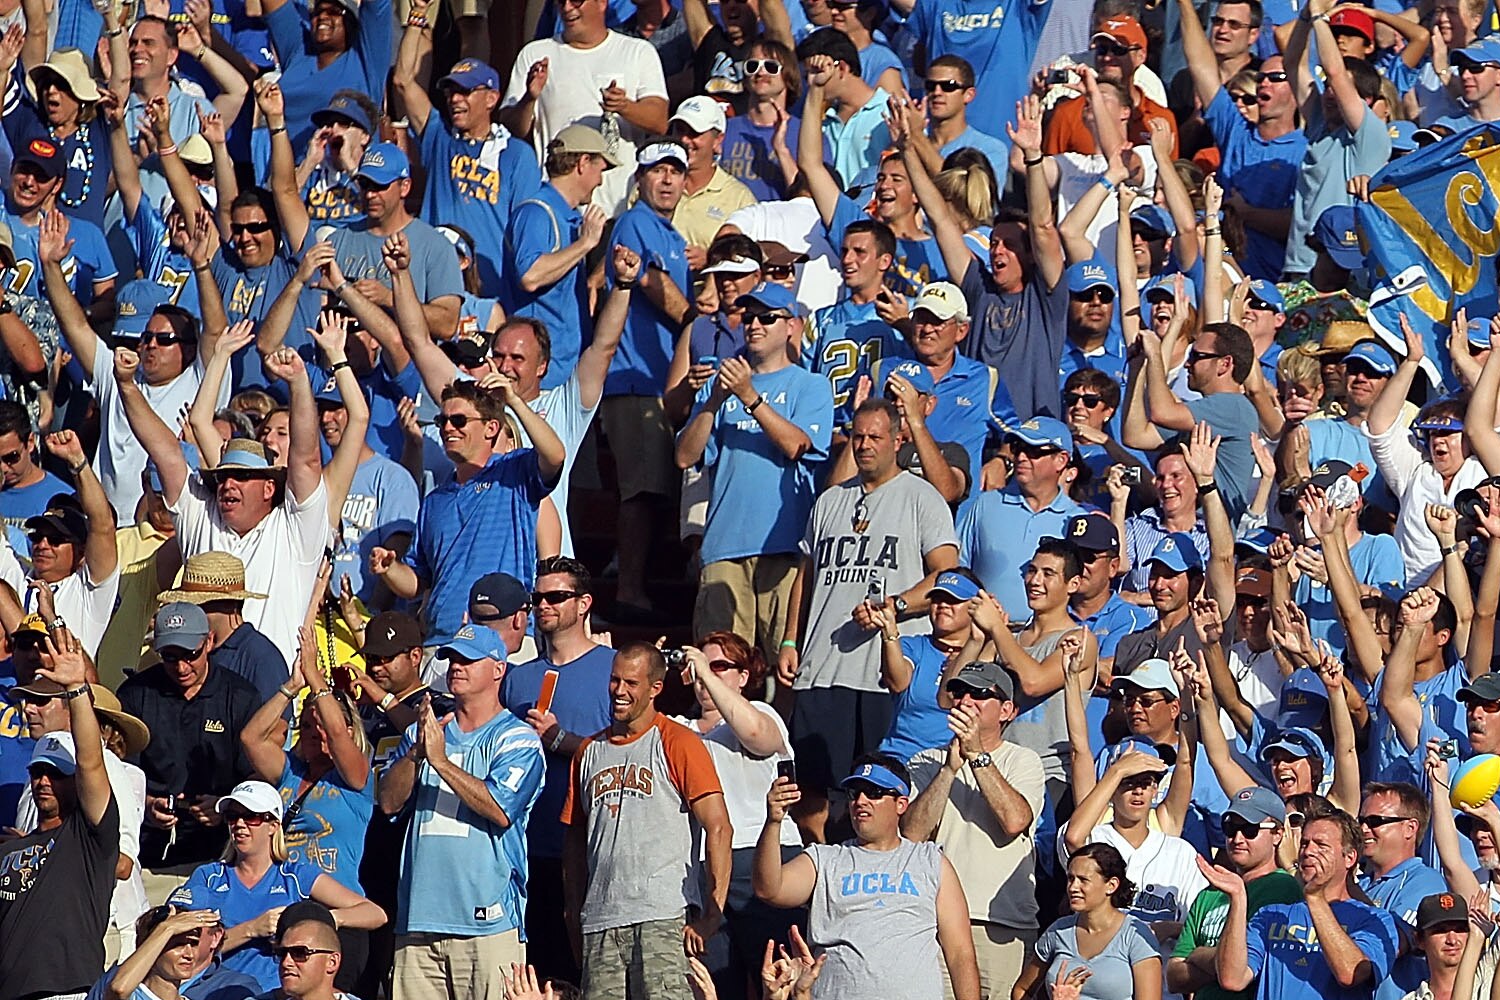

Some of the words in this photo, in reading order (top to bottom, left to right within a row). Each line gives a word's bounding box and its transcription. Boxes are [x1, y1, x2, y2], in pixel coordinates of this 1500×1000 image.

[1083, 265, 1107, 280] Ucla
[1072, 518, 1086, 536] B
[815, 535, 898, 570] UCLA
[1162, 537, 1175, 552] B
[824, 567, 877, 586] BRUINS
[204, 719, 224, 733] Ucla
[501, 766, 523, 792] 1
[862, 764, 871, 777] B
[588, 764, 653, 797] EXAS
[841, 872, 917, 897] UCLA
